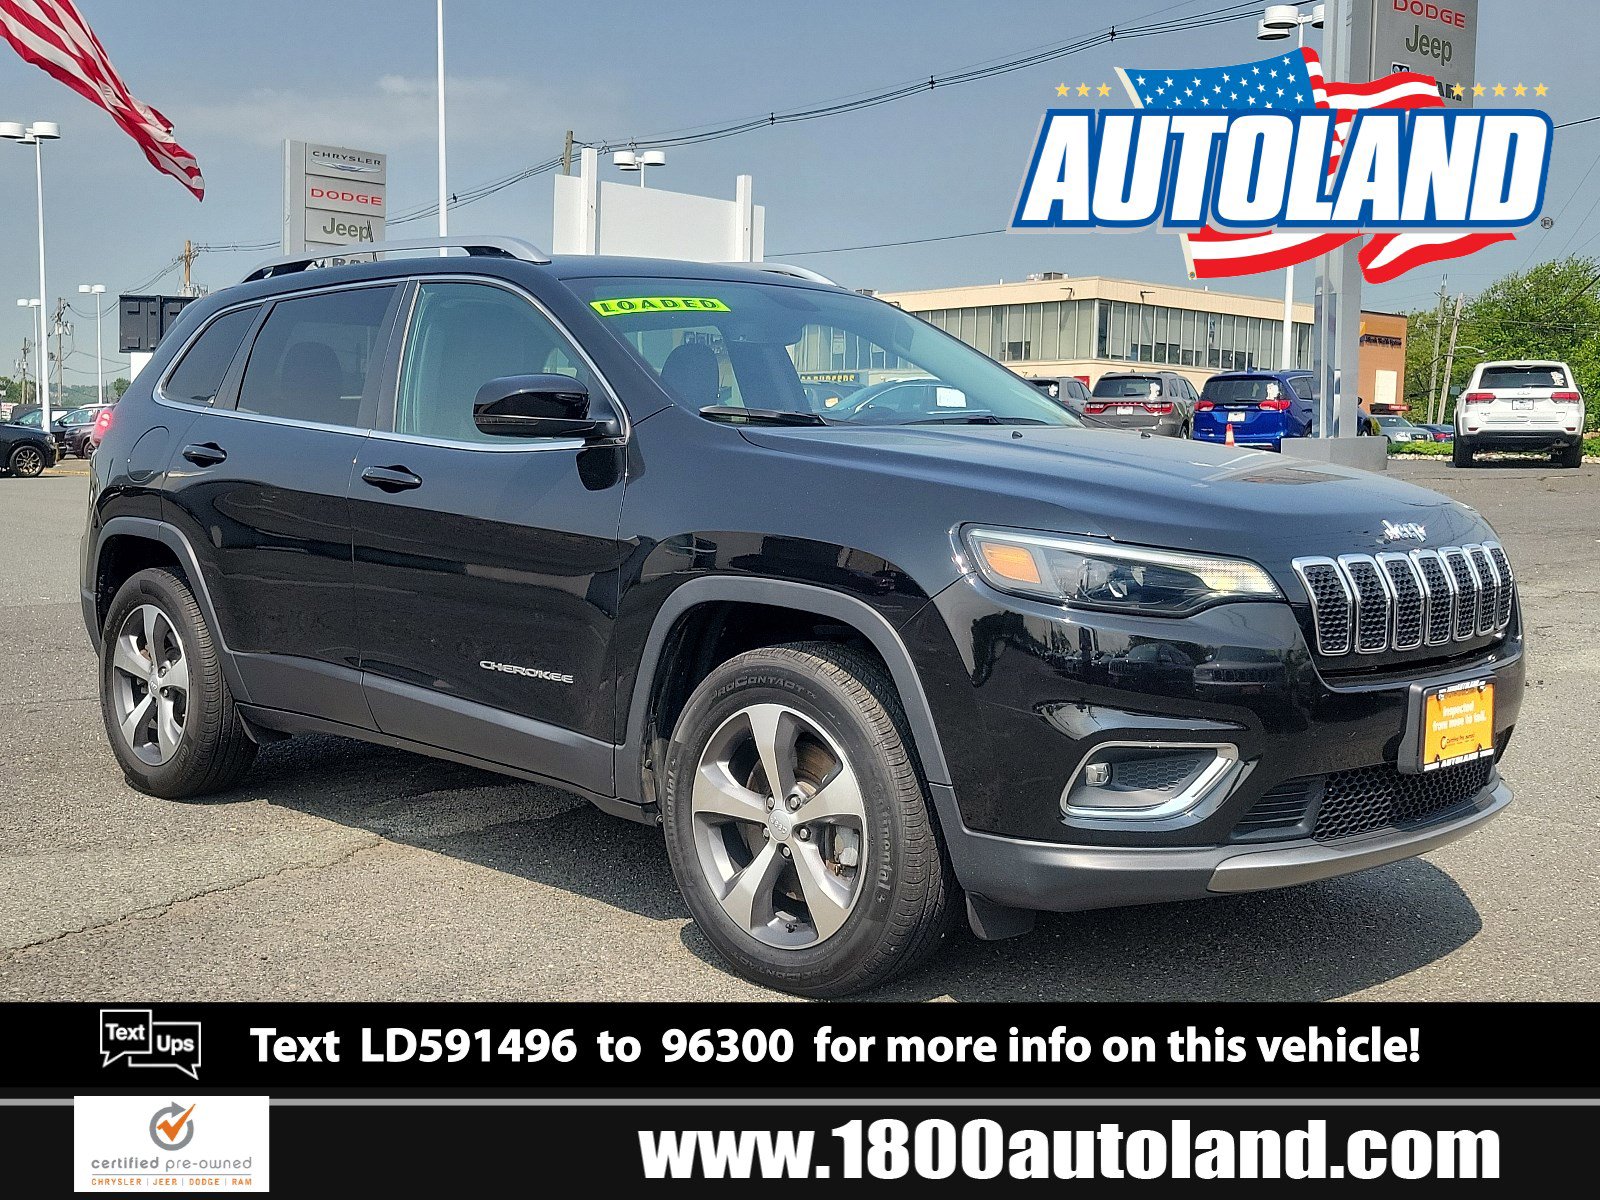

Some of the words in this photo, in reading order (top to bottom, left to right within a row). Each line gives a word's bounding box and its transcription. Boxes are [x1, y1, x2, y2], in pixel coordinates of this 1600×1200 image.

[1393, 0, 1465, 28] DODGE
[1405, 24, 1452, 66] Jeep
[312, 150, 381, 166] CHRYSLER
[311, 188, 382, 206] DODGE
[322, 217, 372, 242] Jeep
[599, 299, 719, 313] LOADED
[1380, 519, 1427, 542] Jeep
[479, 660, 574, 684] CHEROKEE
